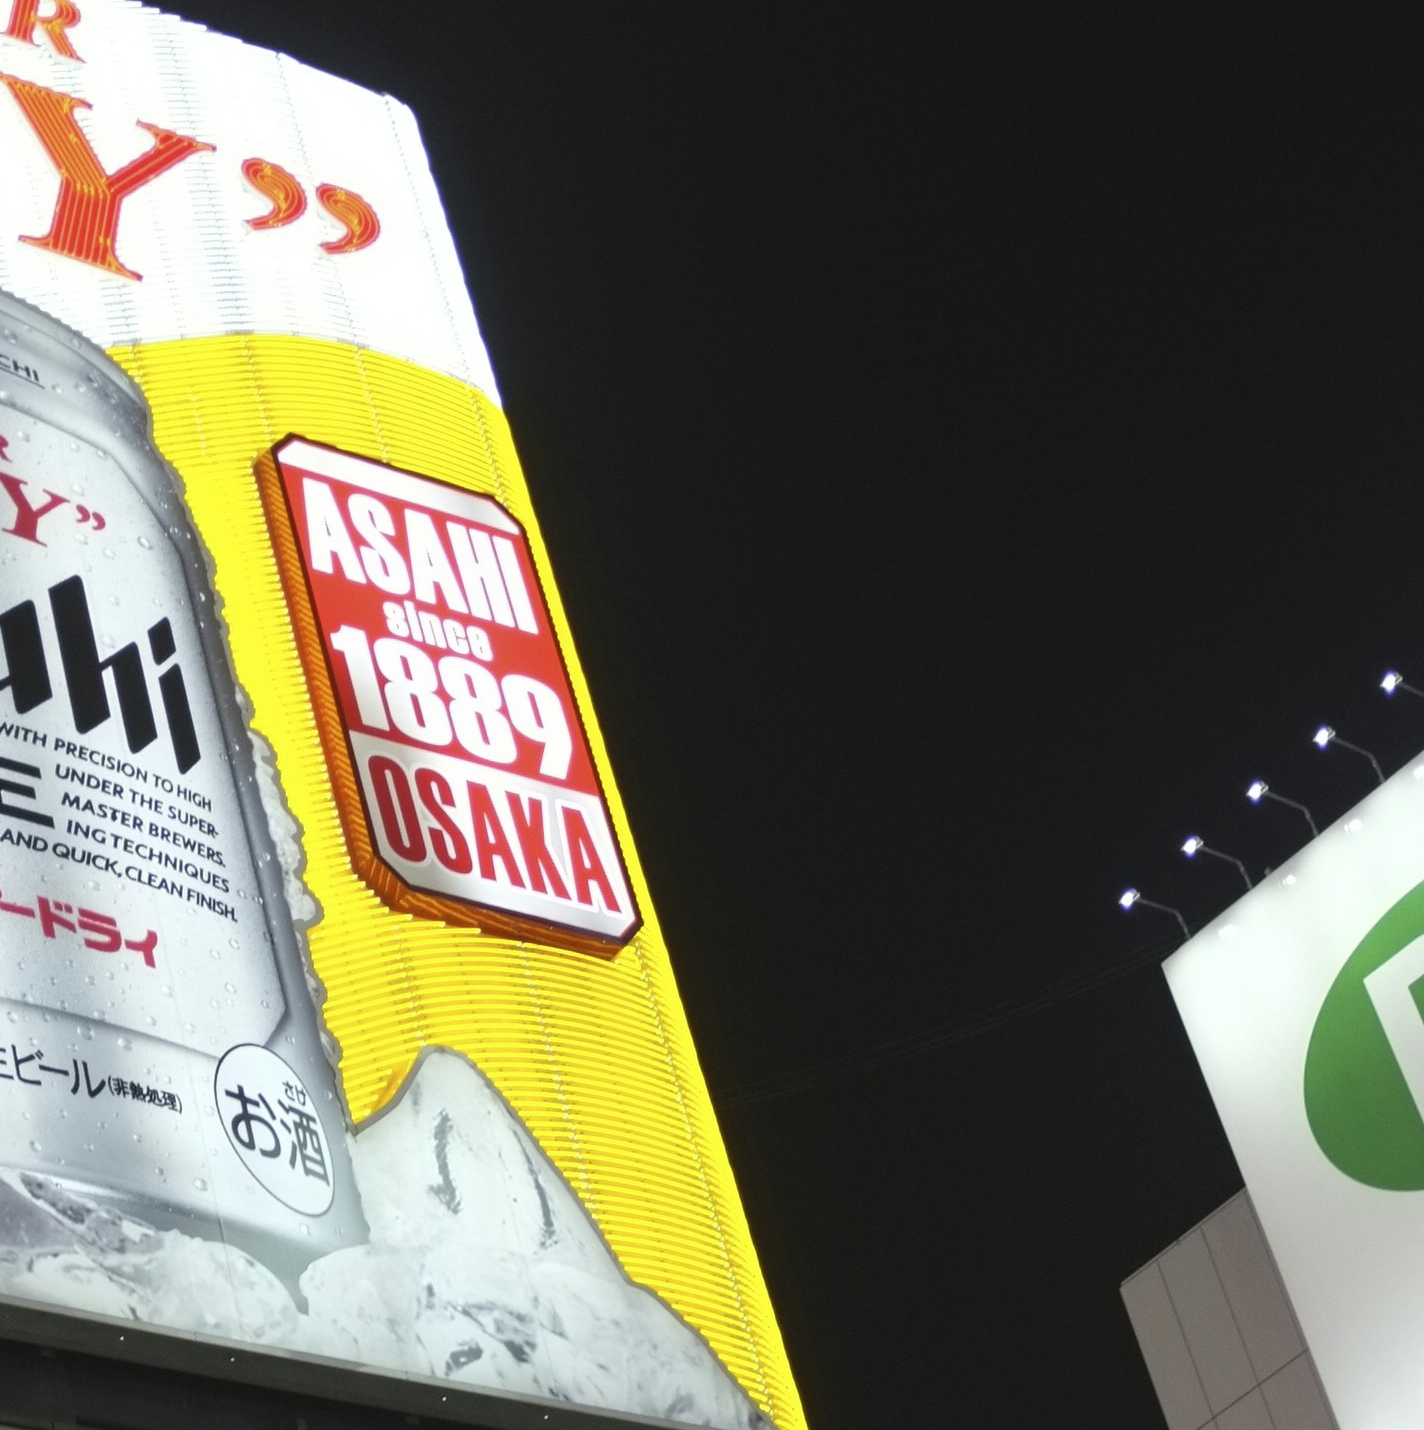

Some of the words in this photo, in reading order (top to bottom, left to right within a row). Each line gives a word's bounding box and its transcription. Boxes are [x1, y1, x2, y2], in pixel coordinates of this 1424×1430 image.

[302, 477, 538, 635] ASAHI
[383, 600, 492, 662] since
[330, 624, 572, 780] 1889
[54, 739, 148, 783] PRECISION
[153, 774, 174, 793] TO
[177, 784, 212, 811] HIGH
[55, 764, 124, 799] UNDER
[129, 789, 163, 814] THE
[0, 828, 48, 852] AND
[52, 842, 123, 878] QUICK,
[125, 865, 184, 898] CLEAN
[61, 792, 144, 830] MASTER
[149, 823, 226, 867] BREWERS.
[66, 820, 107, 844] ING
[110, 833, 230, 893] TECHNIQUES
[368, 755, 622, 913] OSAKA
[225, 1084, 330, 1187] お酒
